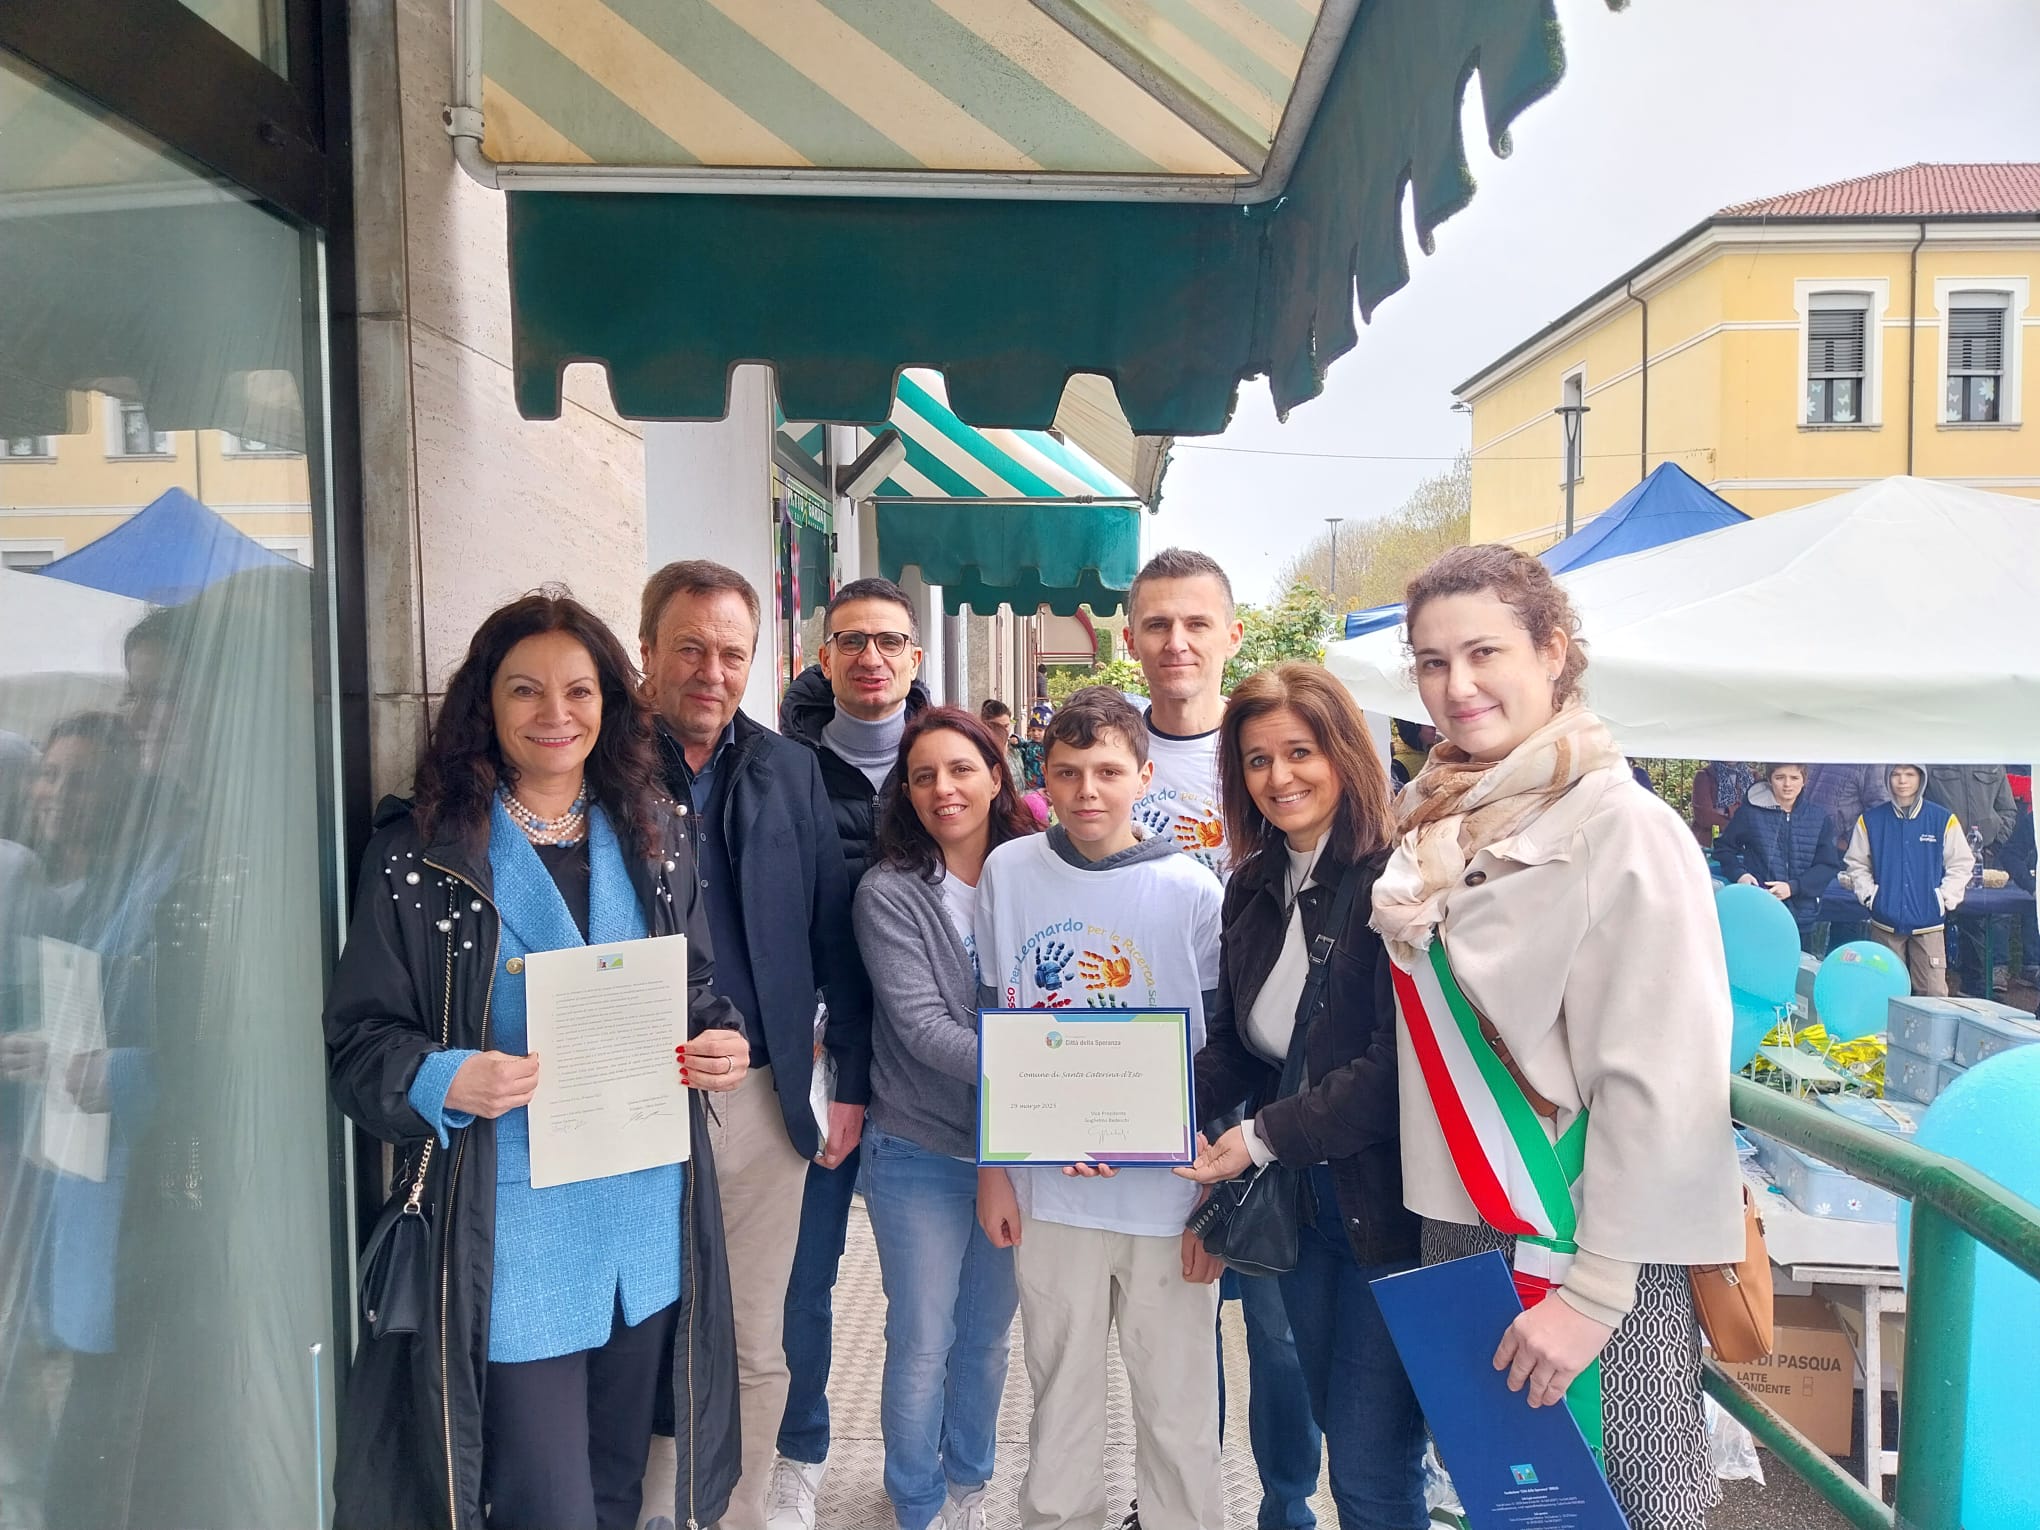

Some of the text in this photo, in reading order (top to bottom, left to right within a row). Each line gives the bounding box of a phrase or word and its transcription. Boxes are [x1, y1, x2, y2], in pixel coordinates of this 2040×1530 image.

[1132, 787, 1176, 812] nardo
[1009, 966, 1021, 985] per
[1015, 917, 1083, 964] Leonardo
[1087, 924, 1107, 935] per
[1109, 931, 1120, 941] la
[1122, 938, 1155, 987] Ricerca
[1095, 1039, 1121, 1048] Speranza
[1018, 1071, 1049, 1079] Comune
[1061, 1071, 1084, 1079] Santa
[1758, 1354, 1772, 1366] DI
[1778, 1354, 1842, 1372] PASQUA
[1737, 1371, 1768, 1383] LATTE
[1739, 1382, 1791, 1395] ONDENTE
